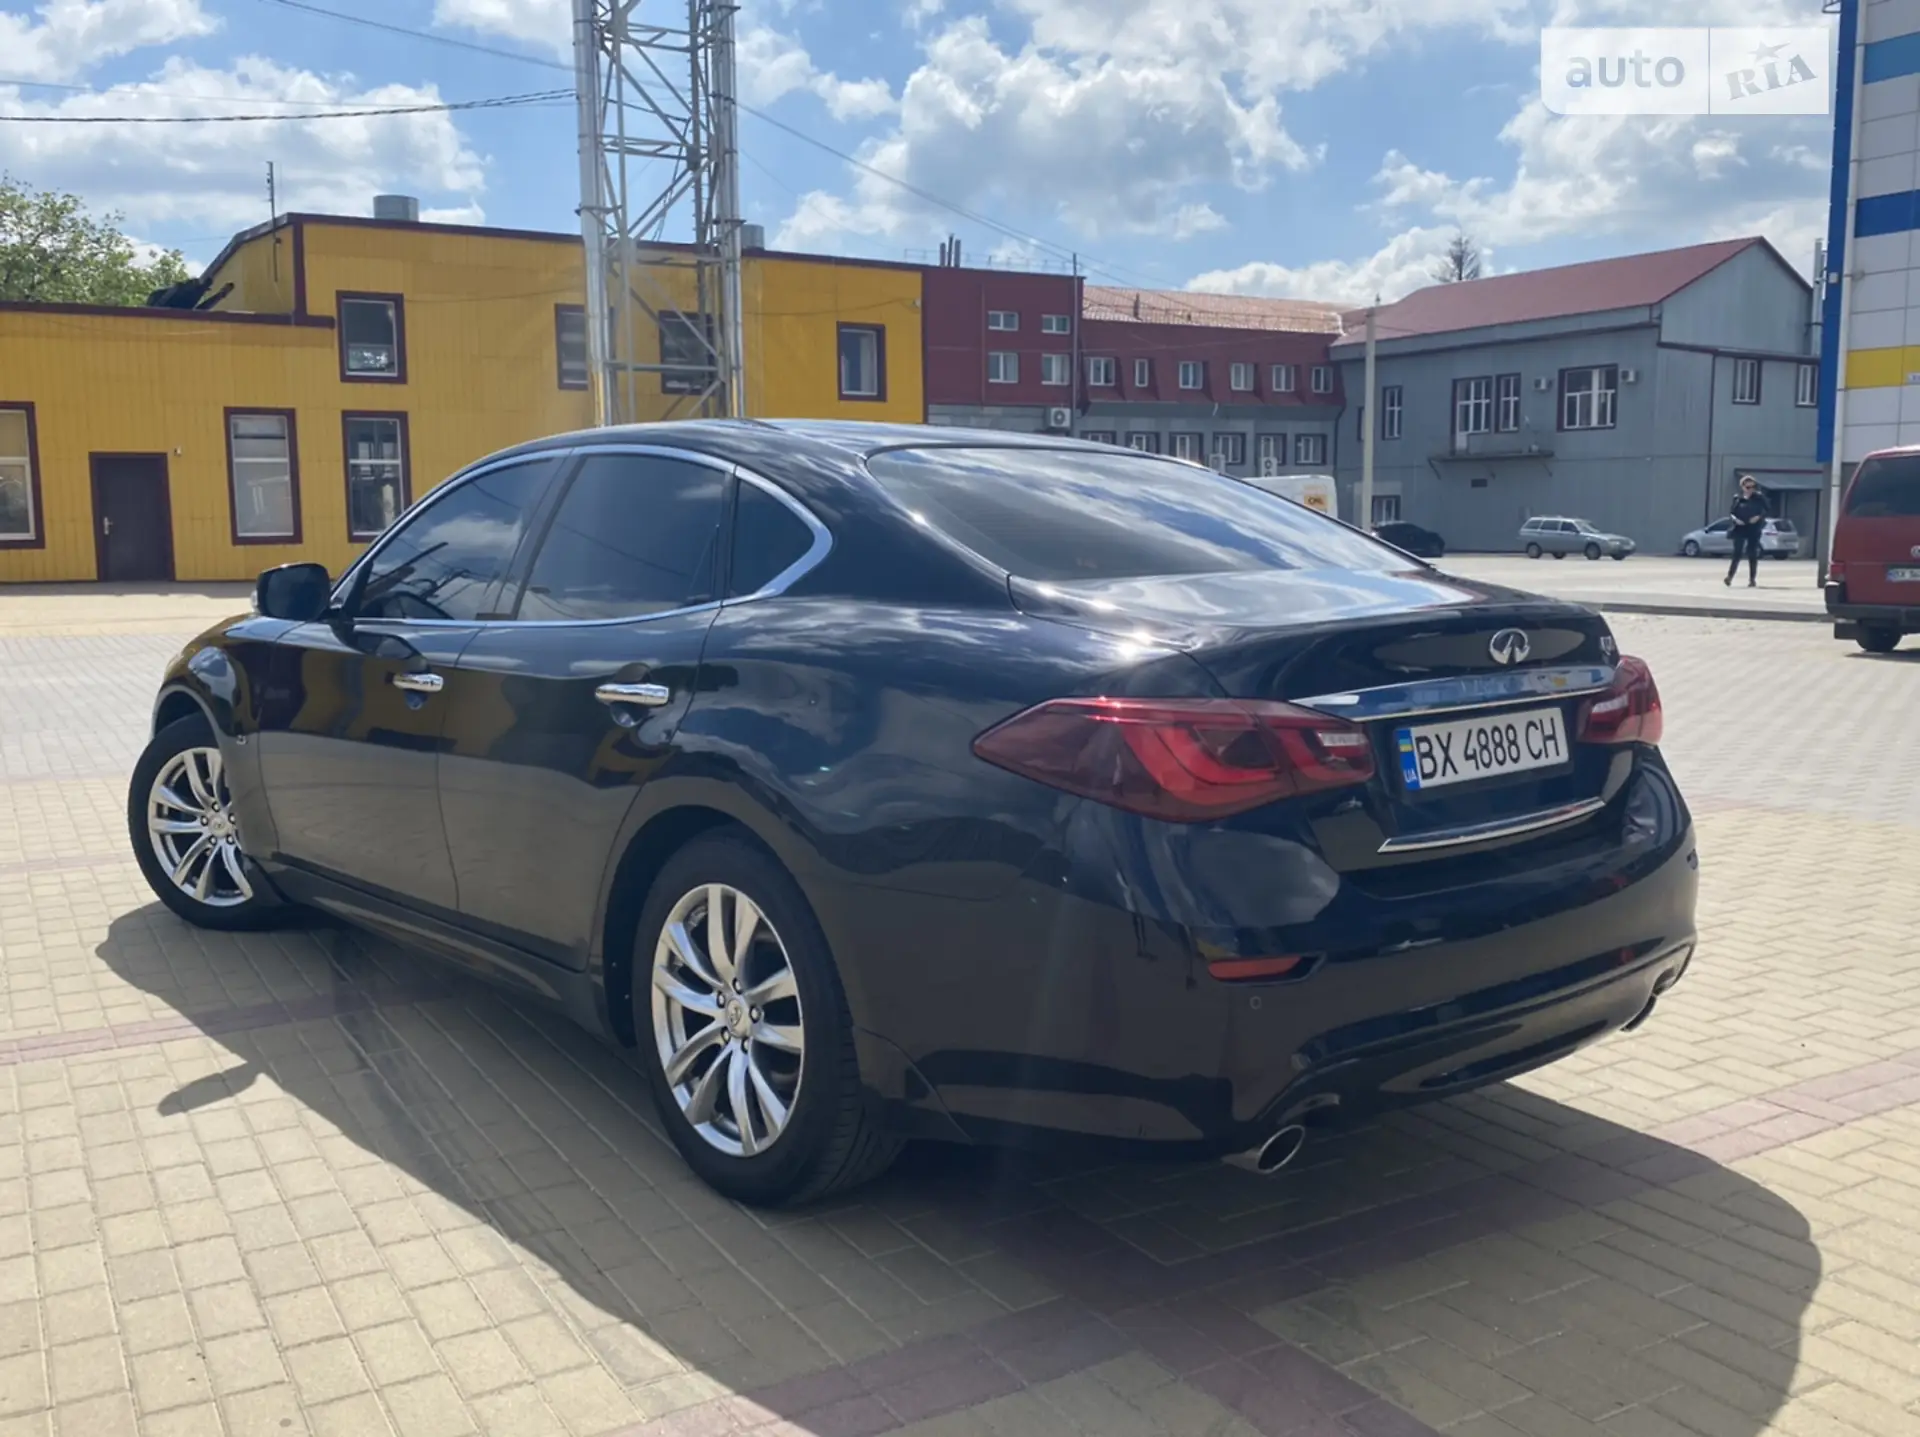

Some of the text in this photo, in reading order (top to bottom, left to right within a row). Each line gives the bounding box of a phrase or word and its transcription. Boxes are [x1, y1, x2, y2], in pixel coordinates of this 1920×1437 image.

[1414, 716, 1560, 780] BX 4888 CH
[1403, 768, 1419, 783] UA
